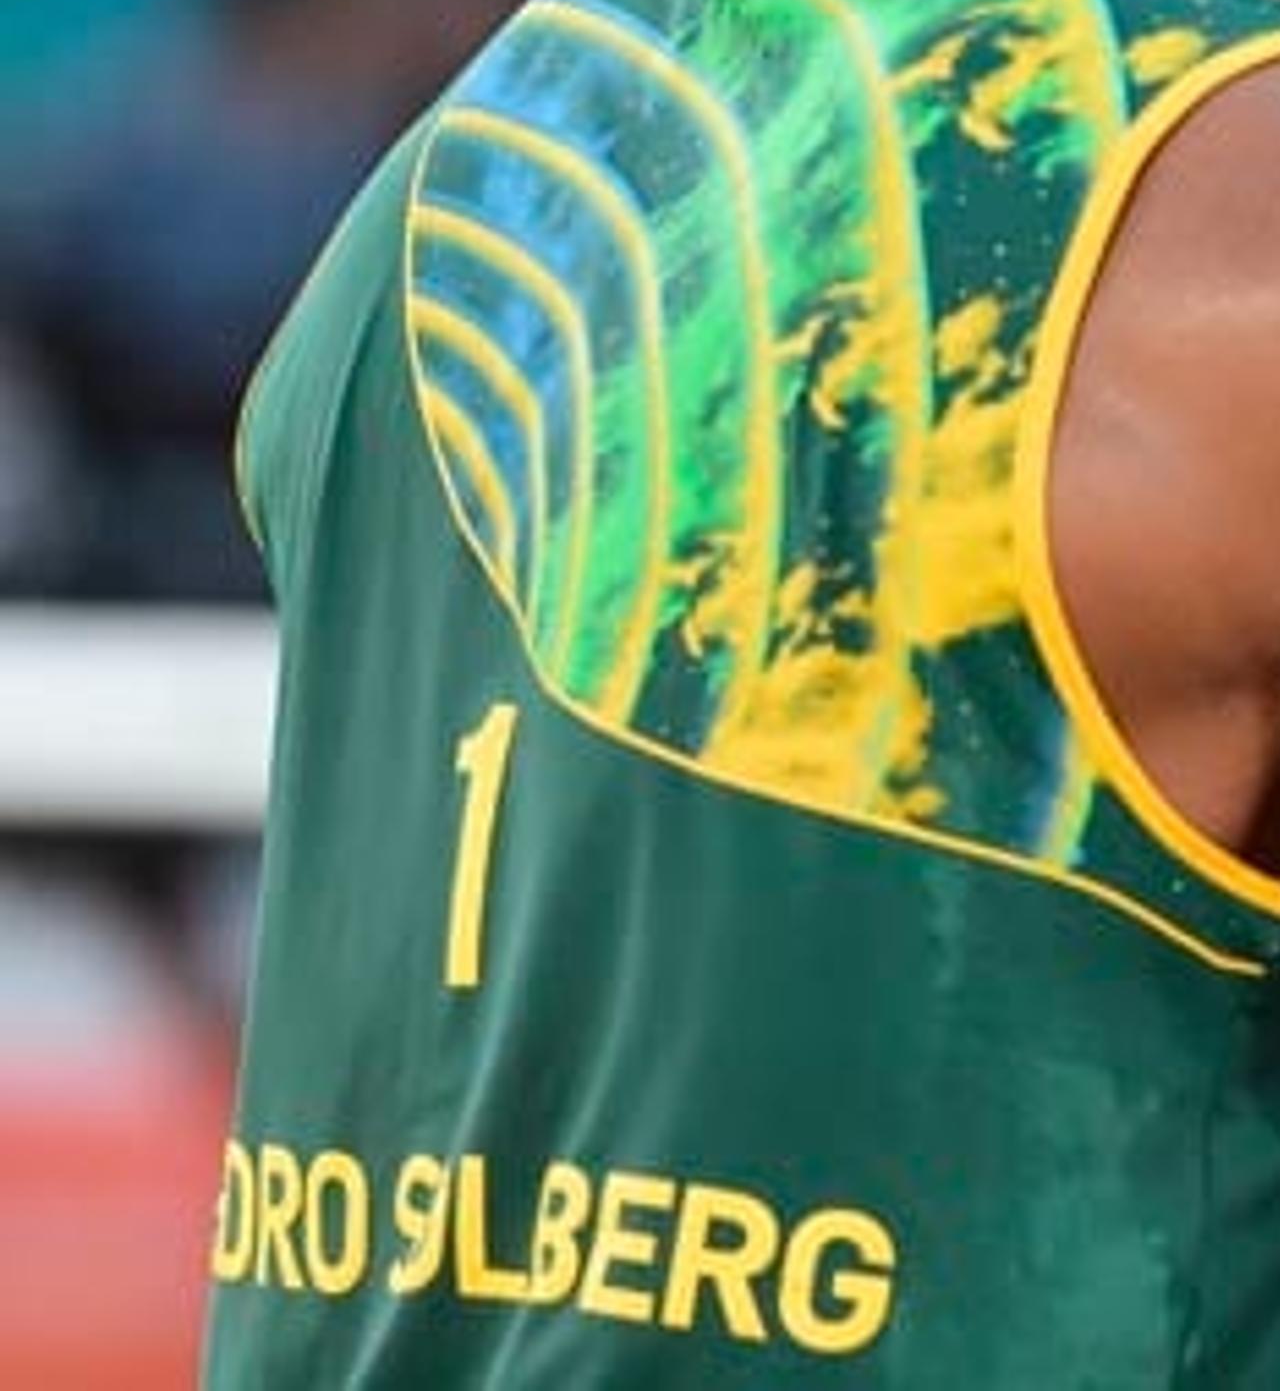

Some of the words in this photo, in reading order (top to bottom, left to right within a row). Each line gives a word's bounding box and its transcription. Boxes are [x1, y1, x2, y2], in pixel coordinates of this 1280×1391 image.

[446, 704, 517, 987] 1
[212, 1139, 369, 1295] DRO
[388, 1153, 896, 1354] SLBERG
